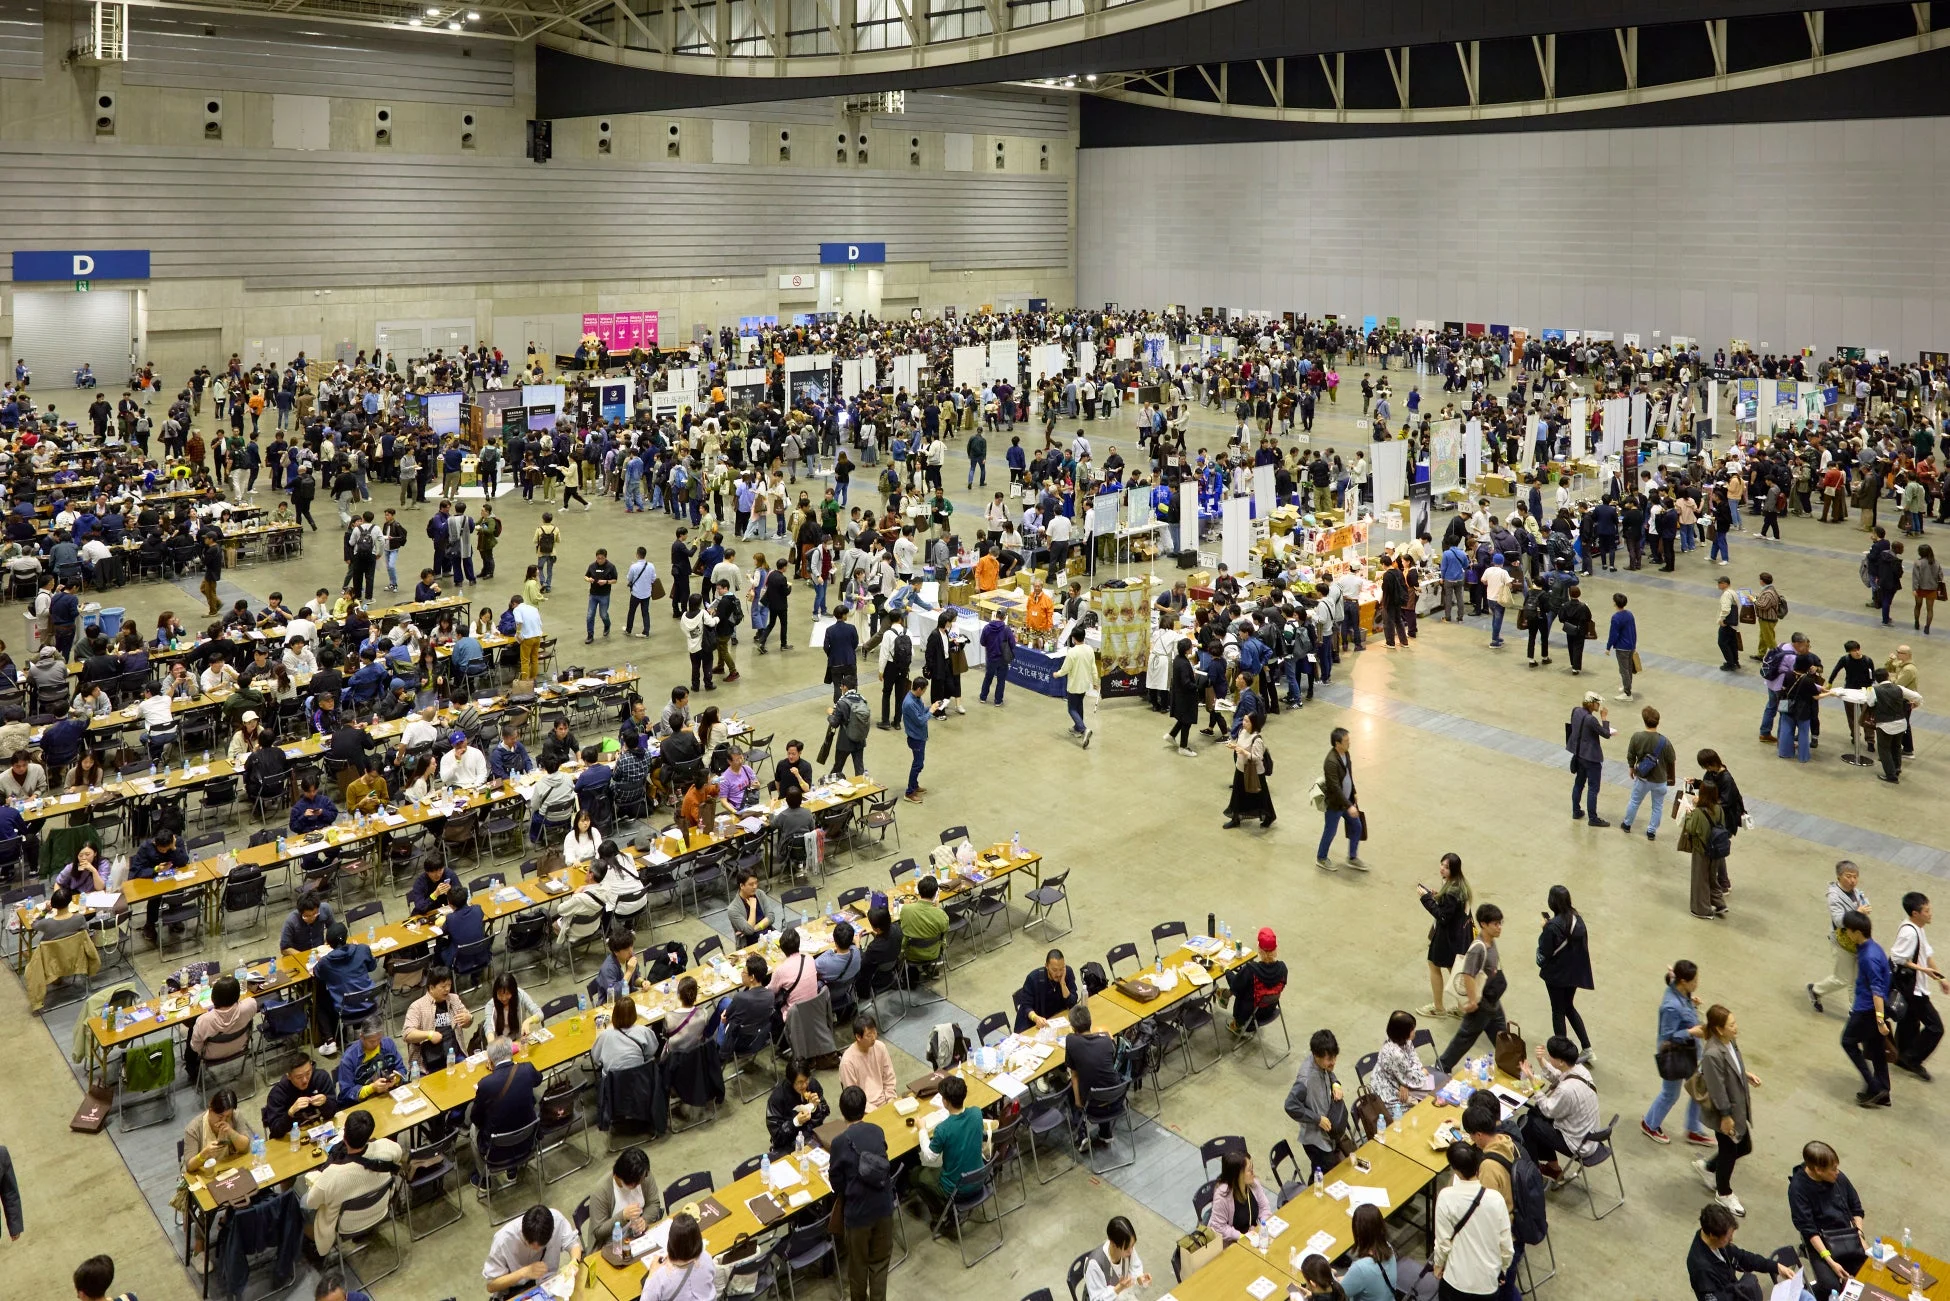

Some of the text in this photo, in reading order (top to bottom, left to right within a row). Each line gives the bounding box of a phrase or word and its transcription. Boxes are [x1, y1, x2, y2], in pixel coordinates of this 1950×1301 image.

[849, 246, 859, 260] D
[73, 255, 94, 275] D
[1203, 556, 1214, 566] 73
